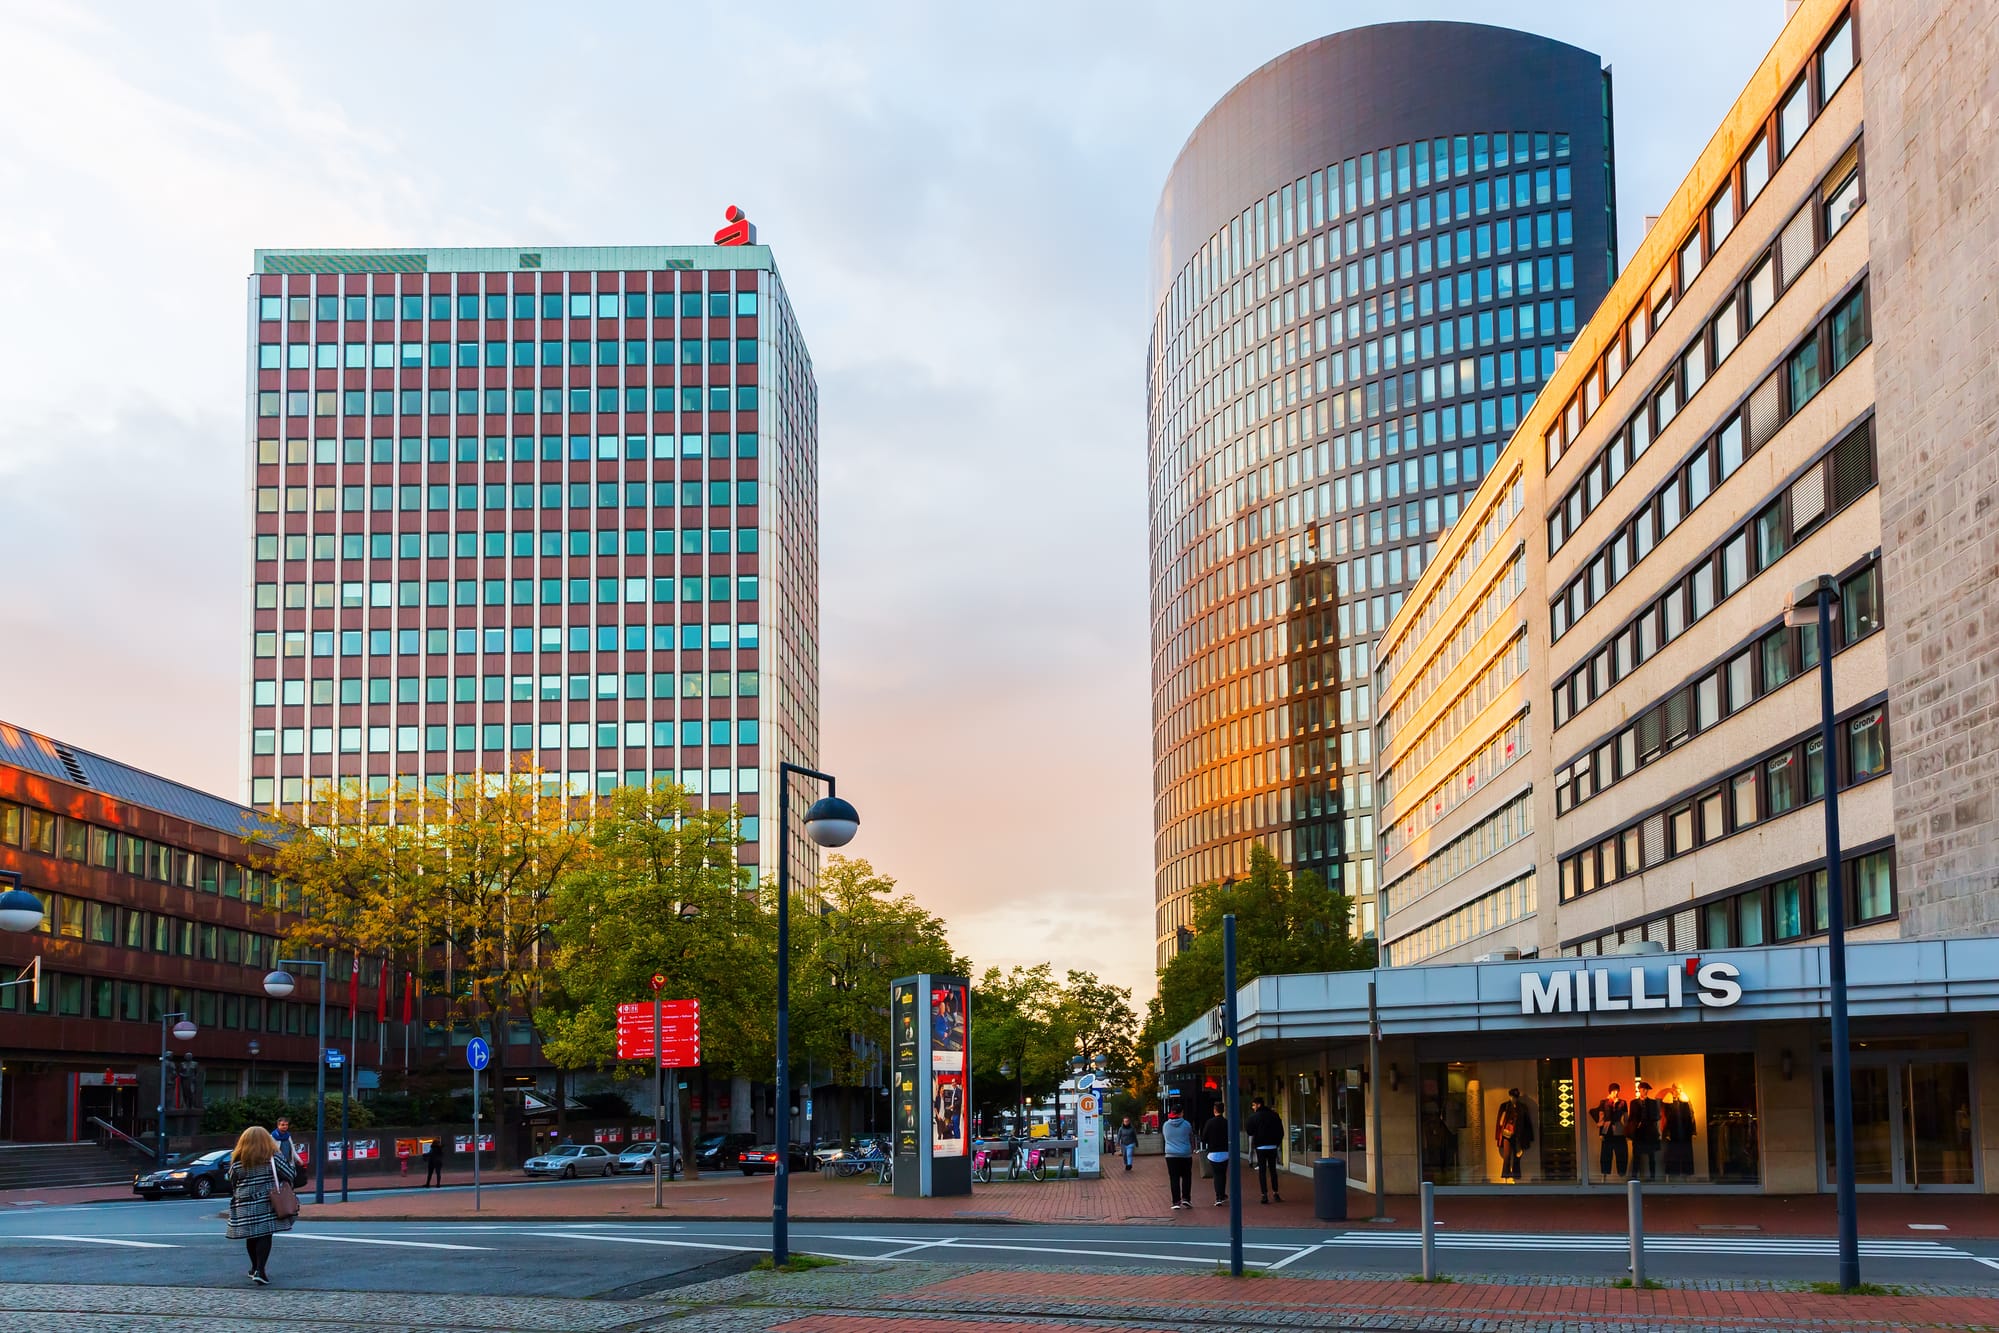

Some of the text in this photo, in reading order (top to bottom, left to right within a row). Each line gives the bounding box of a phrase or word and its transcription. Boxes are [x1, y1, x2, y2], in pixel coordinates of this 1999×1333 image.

[1853, 714, 1876, 731] Grone
[1809, 739, 1824, 751] Gron
[1770, 756, 1788, 770] Grone
[1520, 957, 1743, 1015] MILLI'S
